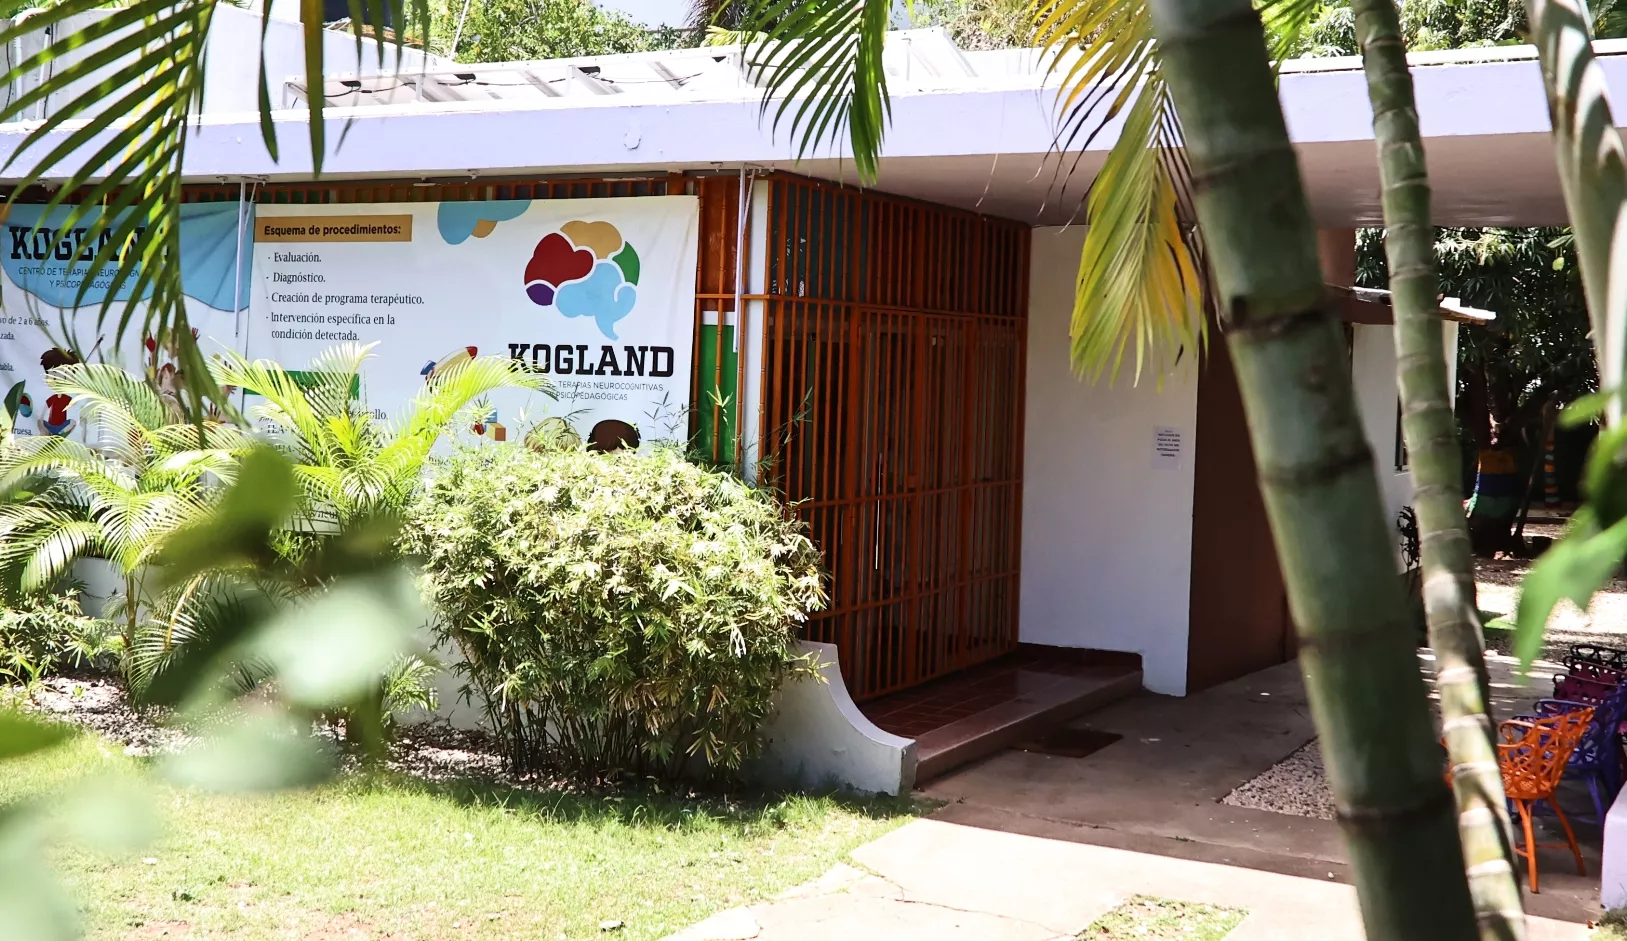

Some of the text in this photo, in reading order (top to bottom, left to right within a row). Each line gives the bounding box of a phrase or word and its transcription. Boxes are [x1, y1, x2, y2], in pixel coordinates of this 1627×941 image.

[264, 224, 401, 237] Esquema de procedimientos:
[274, 252, 321, 262] Evaluación.
[47, 267, 57, 276] DE
[273, 272, 326, 284] Diagnóstico.
[271, 292, 425, 306] Creación de programa terapéutico.
[271, 312, 395, 326] Intervención específica en la
[271, 328, 360, 341] condición detectada.
[508, 343, 674, 377] KOGLAND
[593, 382, 664, 391] NEUROCOGNITIVAS
